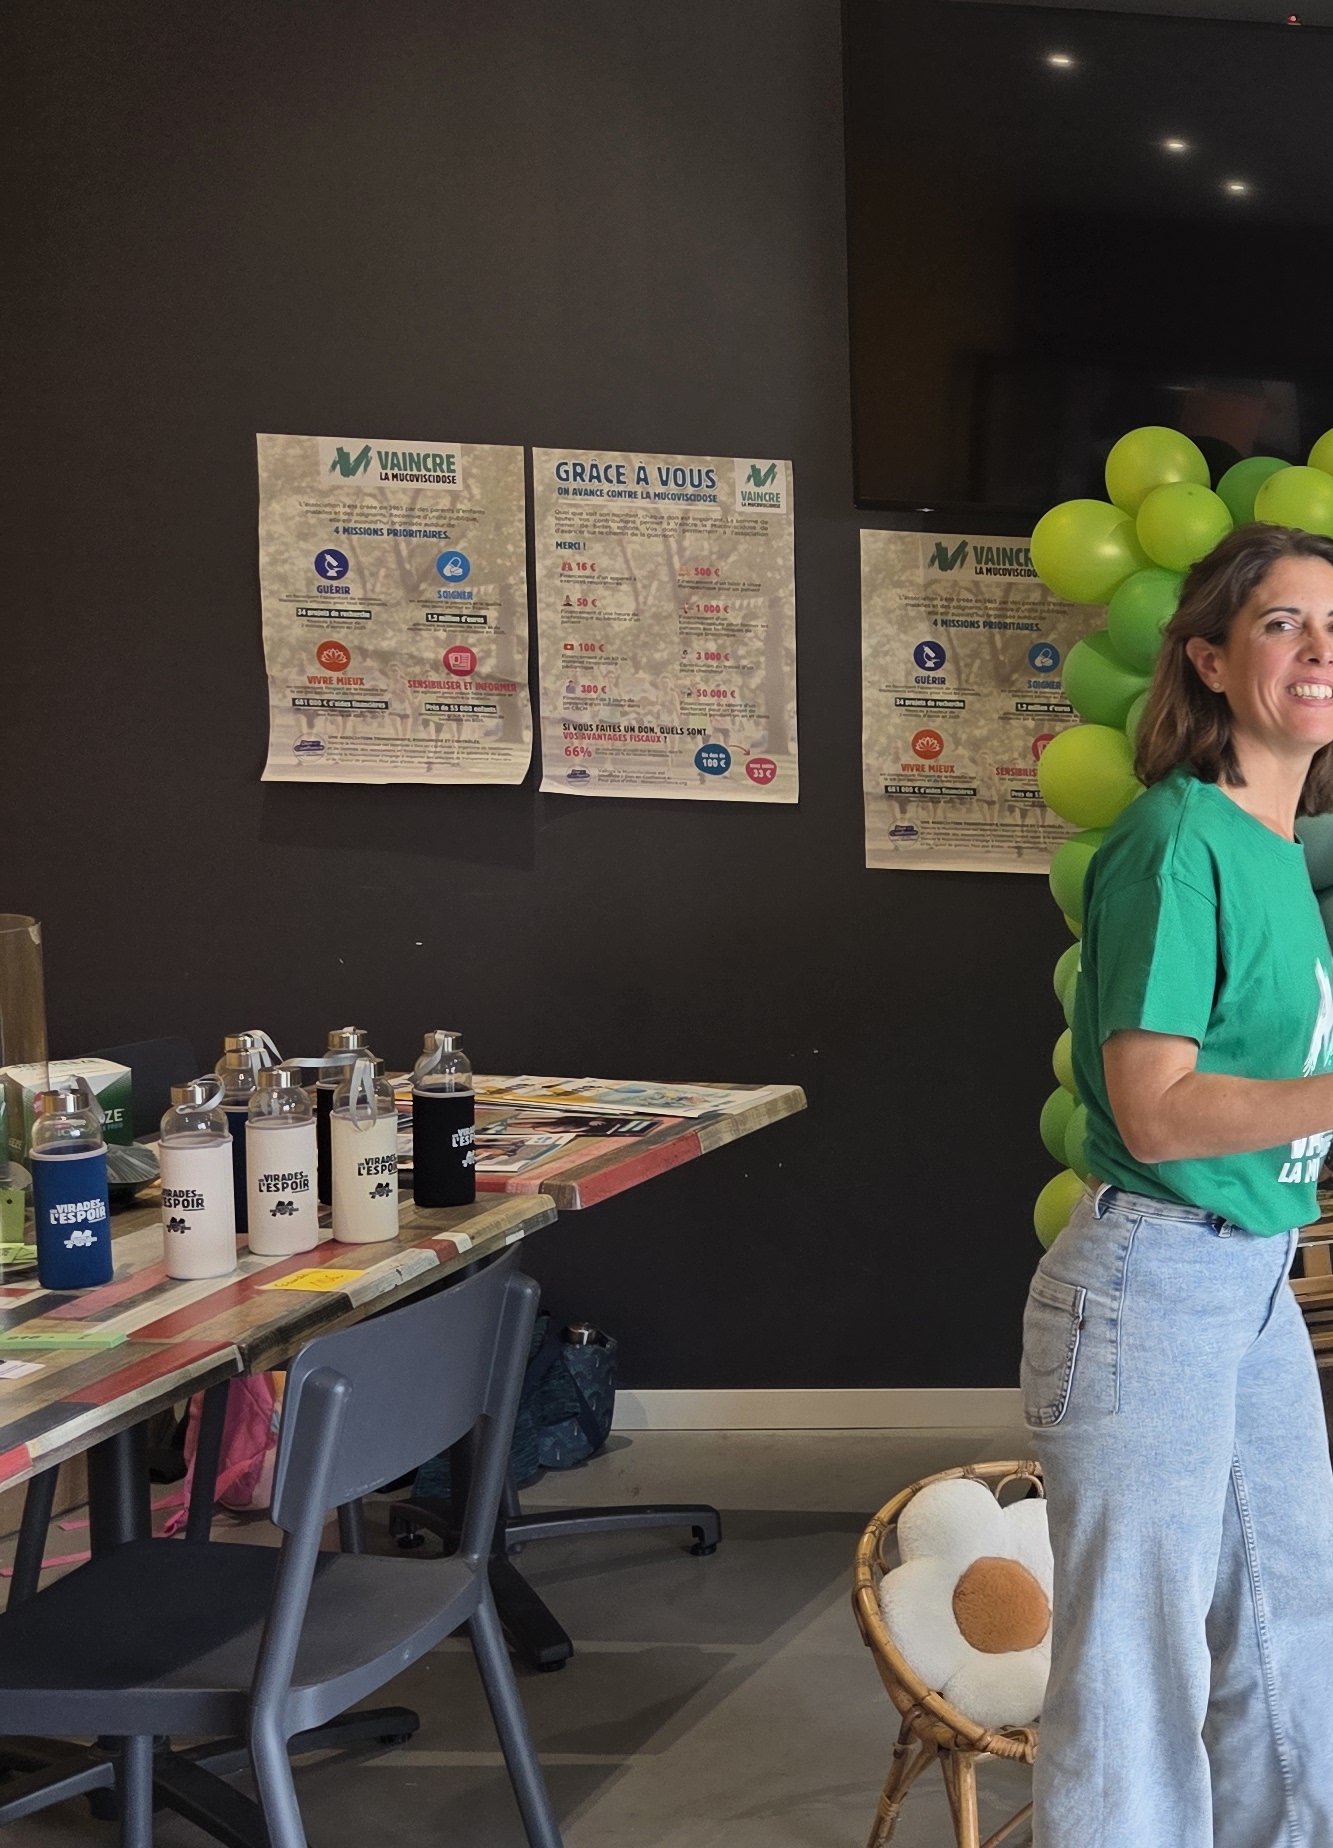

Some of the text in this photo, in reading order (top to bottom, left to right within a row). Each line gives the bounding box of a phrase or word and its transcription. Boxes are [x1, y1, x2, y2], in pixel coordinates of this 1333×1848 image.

[376, 450, 456, 474] VAINCRE
[380, 472, 457, 484] LA MUCOVISCIDOSE
[555, 459, 717, 489] GRÂCE À VOUS
[557, 486, 718, 503] ON AVANCE CONTRE LA MUCOVISCIDOSE
[740, 490, 781, 503] VAINCRE
[333, 526, 340, 535] 4
[343, 527, 384, 537] MISSIONS
[555, 541, 582, 551] MERCI
[974, 566, 1040, 578] LA MUCOVISCIDO
[316, 583, 351, 595] GUÉRIR
[437, 590, 473, 601] SOIGNER
[932, 618, 939, 628] 4
[941, 619, 981, 630] MISSIONS
[307, 675, 365, 686] VIVRE MIEUX
[408, 679, 517, 692] SENSIBILISER ET INFORMER
[914, 674, 946, 685] GUÉRIR
[1027, 680, 1061, 690] SOIGNER
[562, 723, 571, 732] SI
[572, 723, 594, 733] VOUS
[596, 724, 622, 733] FAITES
[623, 725, 636, 733] UN
[659, 727, 685, 736] QUELS
[687, 728, 707, 736] SONT
[563, 733, 579, 741] VOS
[581, 733, 628, 742] AVANTAGES
[629, 734, 662, 743] FISCAUX
[564, 746, 593, 759] 66%
[702, 758, 726, 768] 100 €
[901, 763, 955, 774] VIVRE MIEUX
[753, 769, 772, 778] 33 €
[365, 1154, 397, 1166] VIRADES
[358, 1162, 398, 1176] L'ESPO
[1278, 1162, 1302, 1183] LA
[264, 1171, 304, 1183] VIRADES
[259, 1179, 309, 1193] L'ESPOIR
[56, 1199, 101, 1214] VIRADES
[50, 1206, 106, 1224] L'ESPOIR
